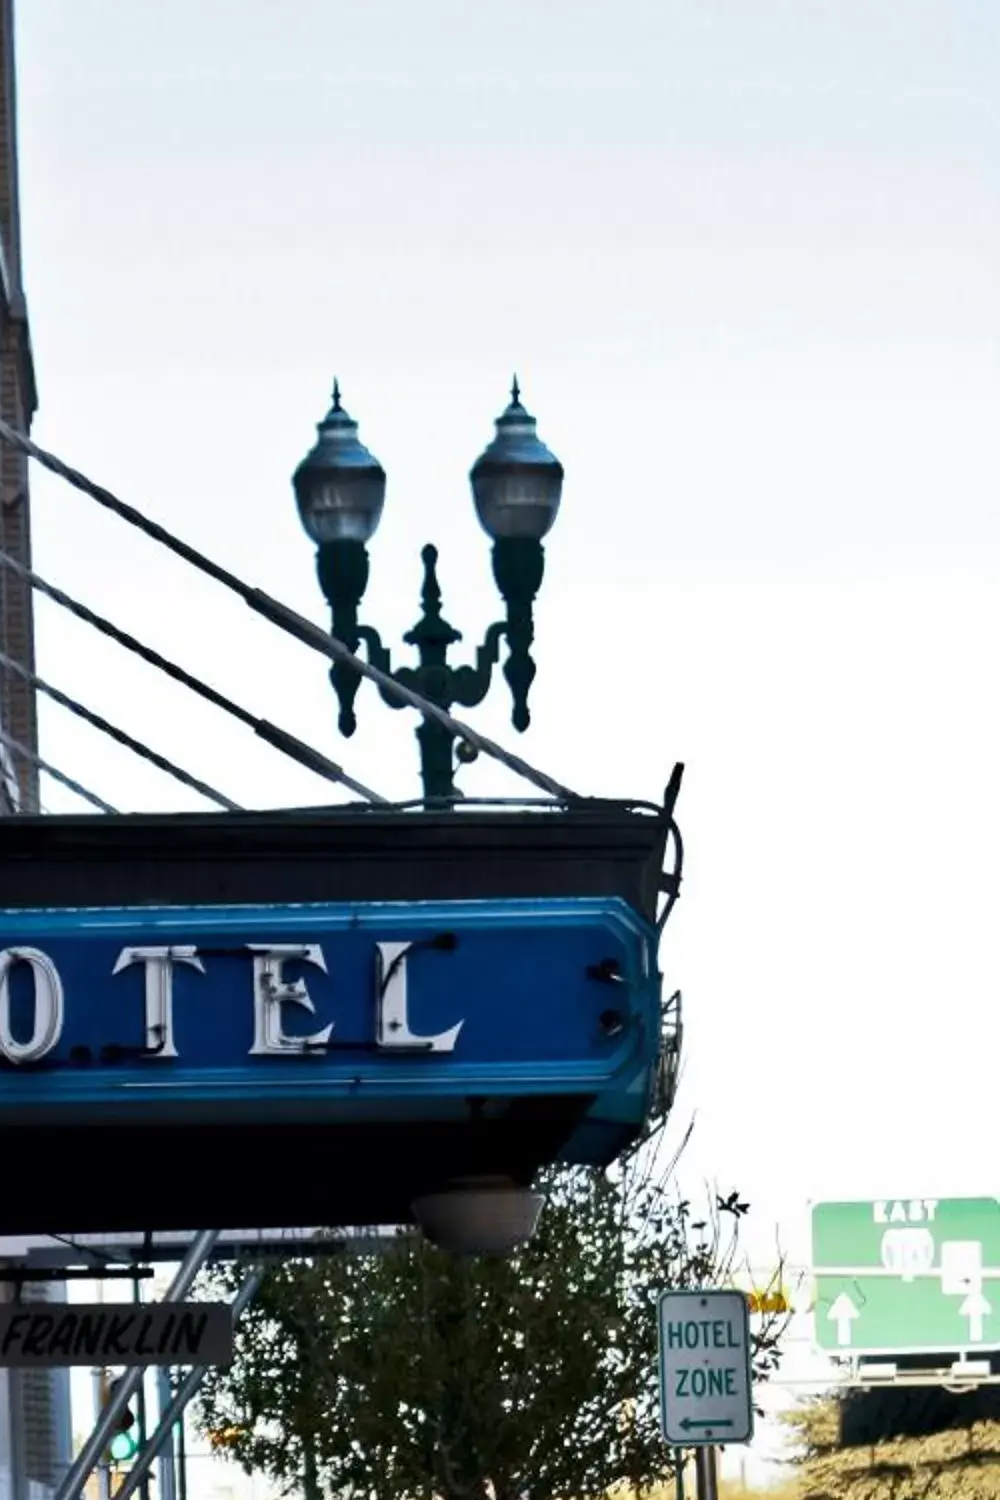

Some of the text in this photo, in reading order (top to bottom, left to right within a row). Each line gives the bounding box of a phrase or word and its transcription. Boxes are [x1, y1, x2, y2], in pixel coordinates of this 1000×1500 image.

[873, 1200, 939, 1223] EAST
[1, 1311, 209, 1357] FRANKLIN
[667, 1320, 741, 1349] HOTEL
[675, 1367, 739, 1398] ZONE
